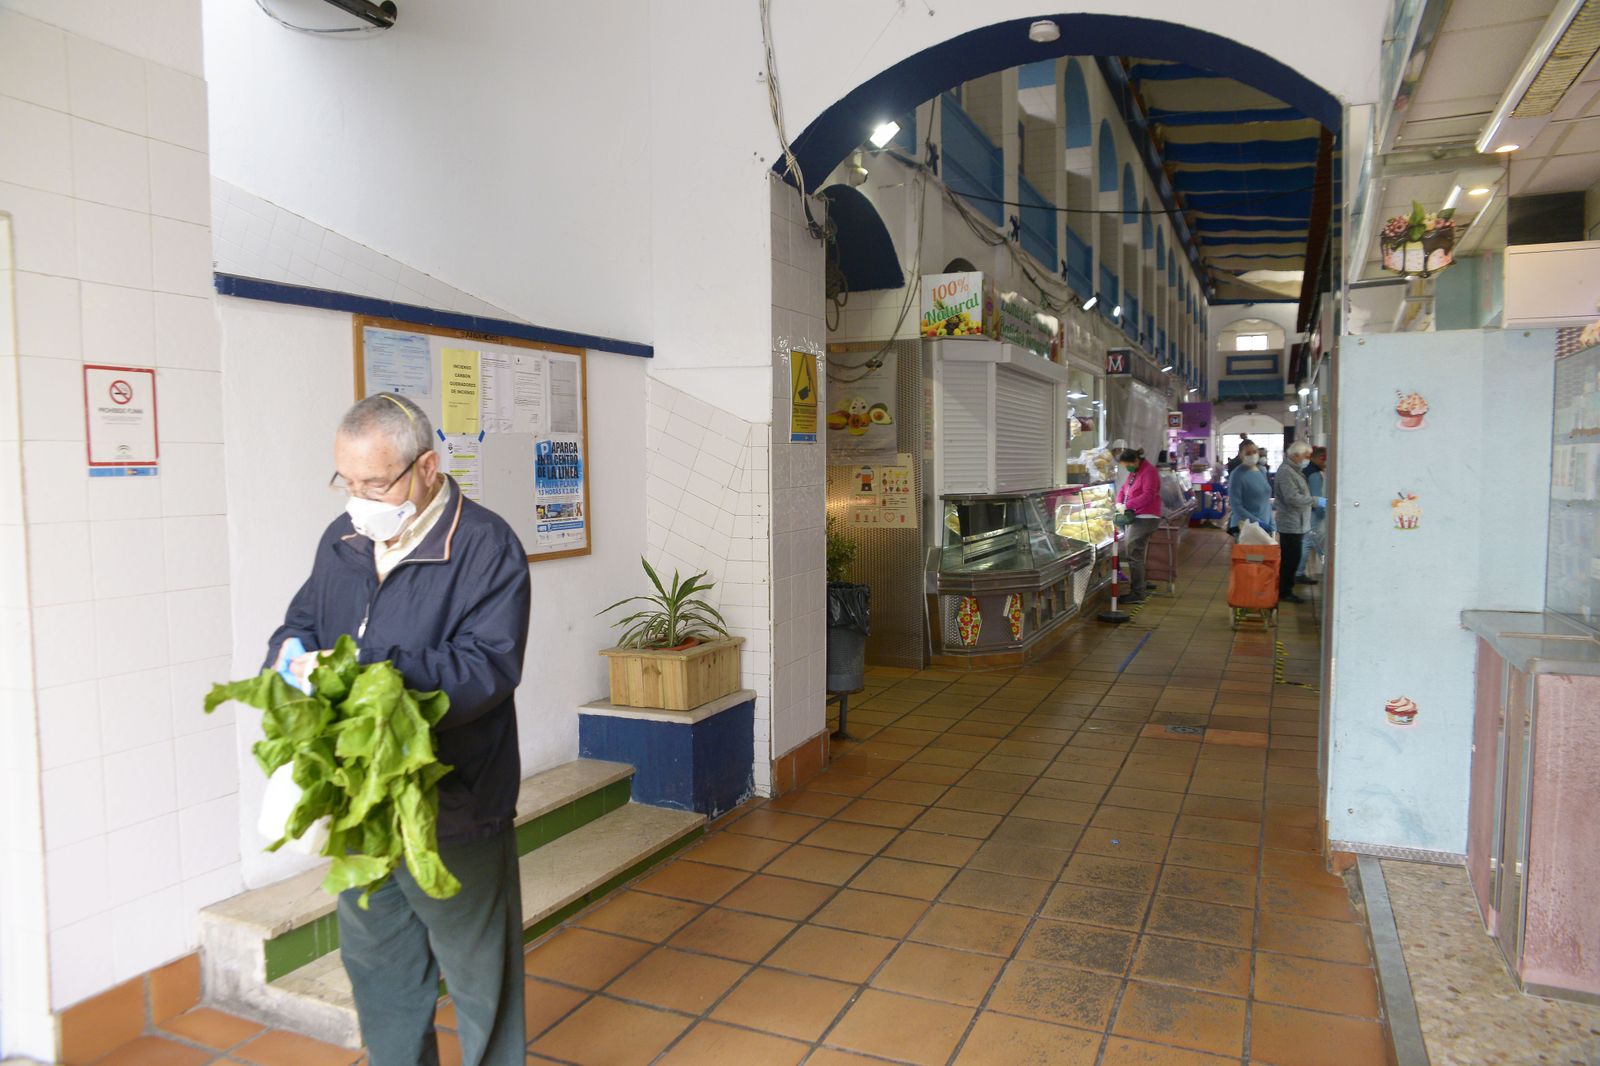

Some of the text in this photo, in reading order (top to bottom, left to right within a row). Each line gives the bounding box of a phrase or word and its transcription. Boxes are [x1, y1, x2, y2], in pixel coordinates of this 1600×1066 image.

[932, 277, 969, 304] 100%
[924, 293, 979, 326] Natural
[552, 442, 578, 453] APARCA
[554, 455, 579, 465] CENTRO
[537, 466, 546, 478] DE
